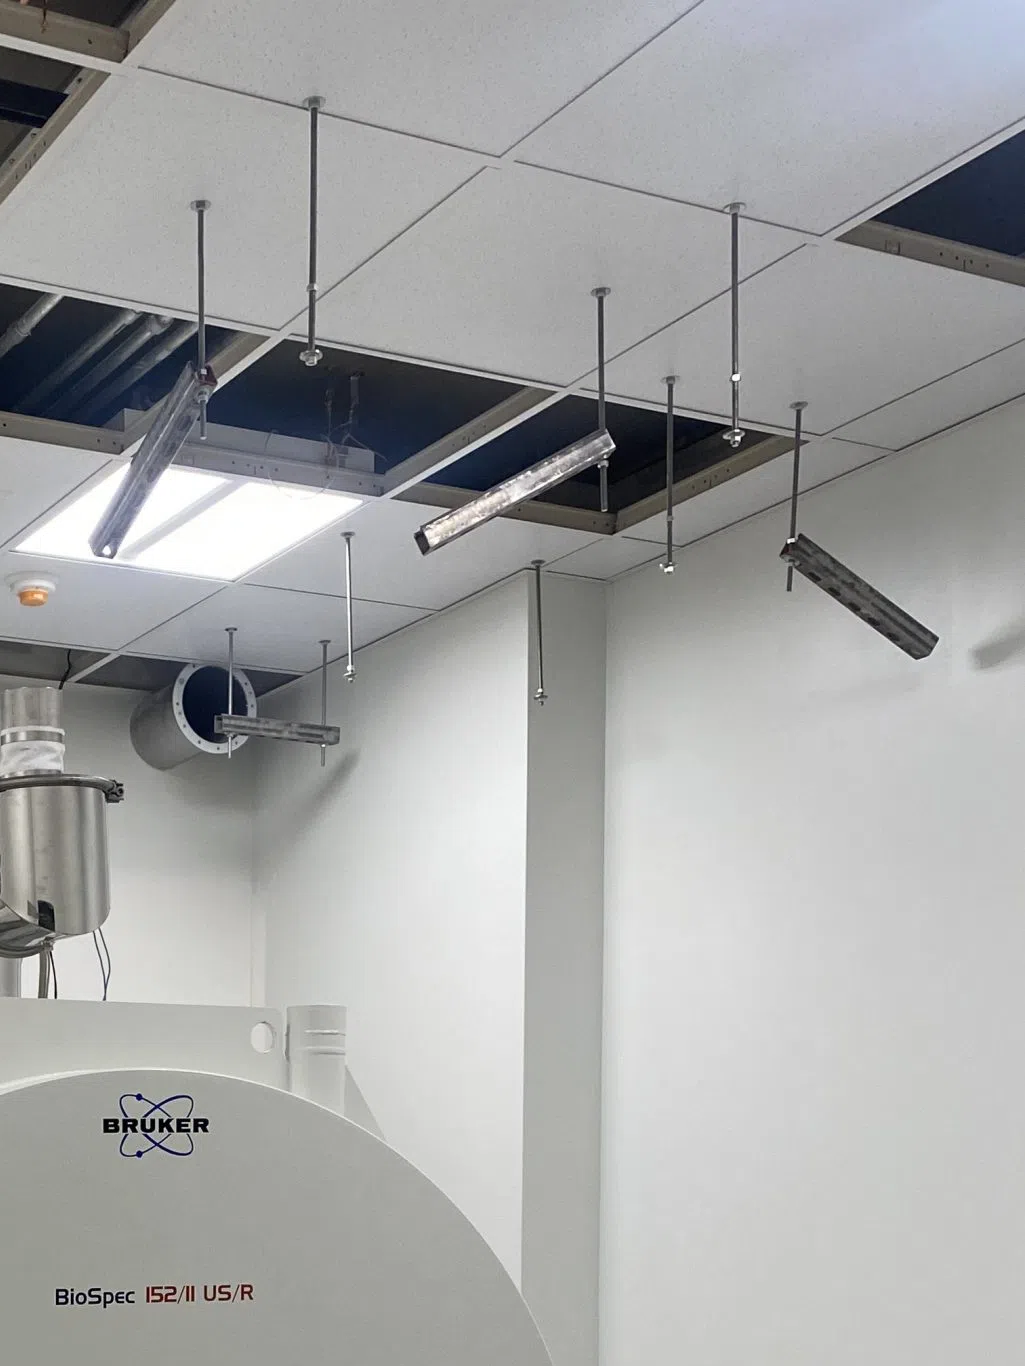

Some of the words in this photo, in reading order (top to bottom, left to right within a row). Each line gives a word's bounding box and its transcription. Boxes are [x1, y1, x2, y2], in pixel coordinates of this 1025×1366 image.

[102, 1117, 210, 1134] BRUKER
[54, 1287, 136, 1309] BioSpec
[203, 1284, 254, 1303] US/R
